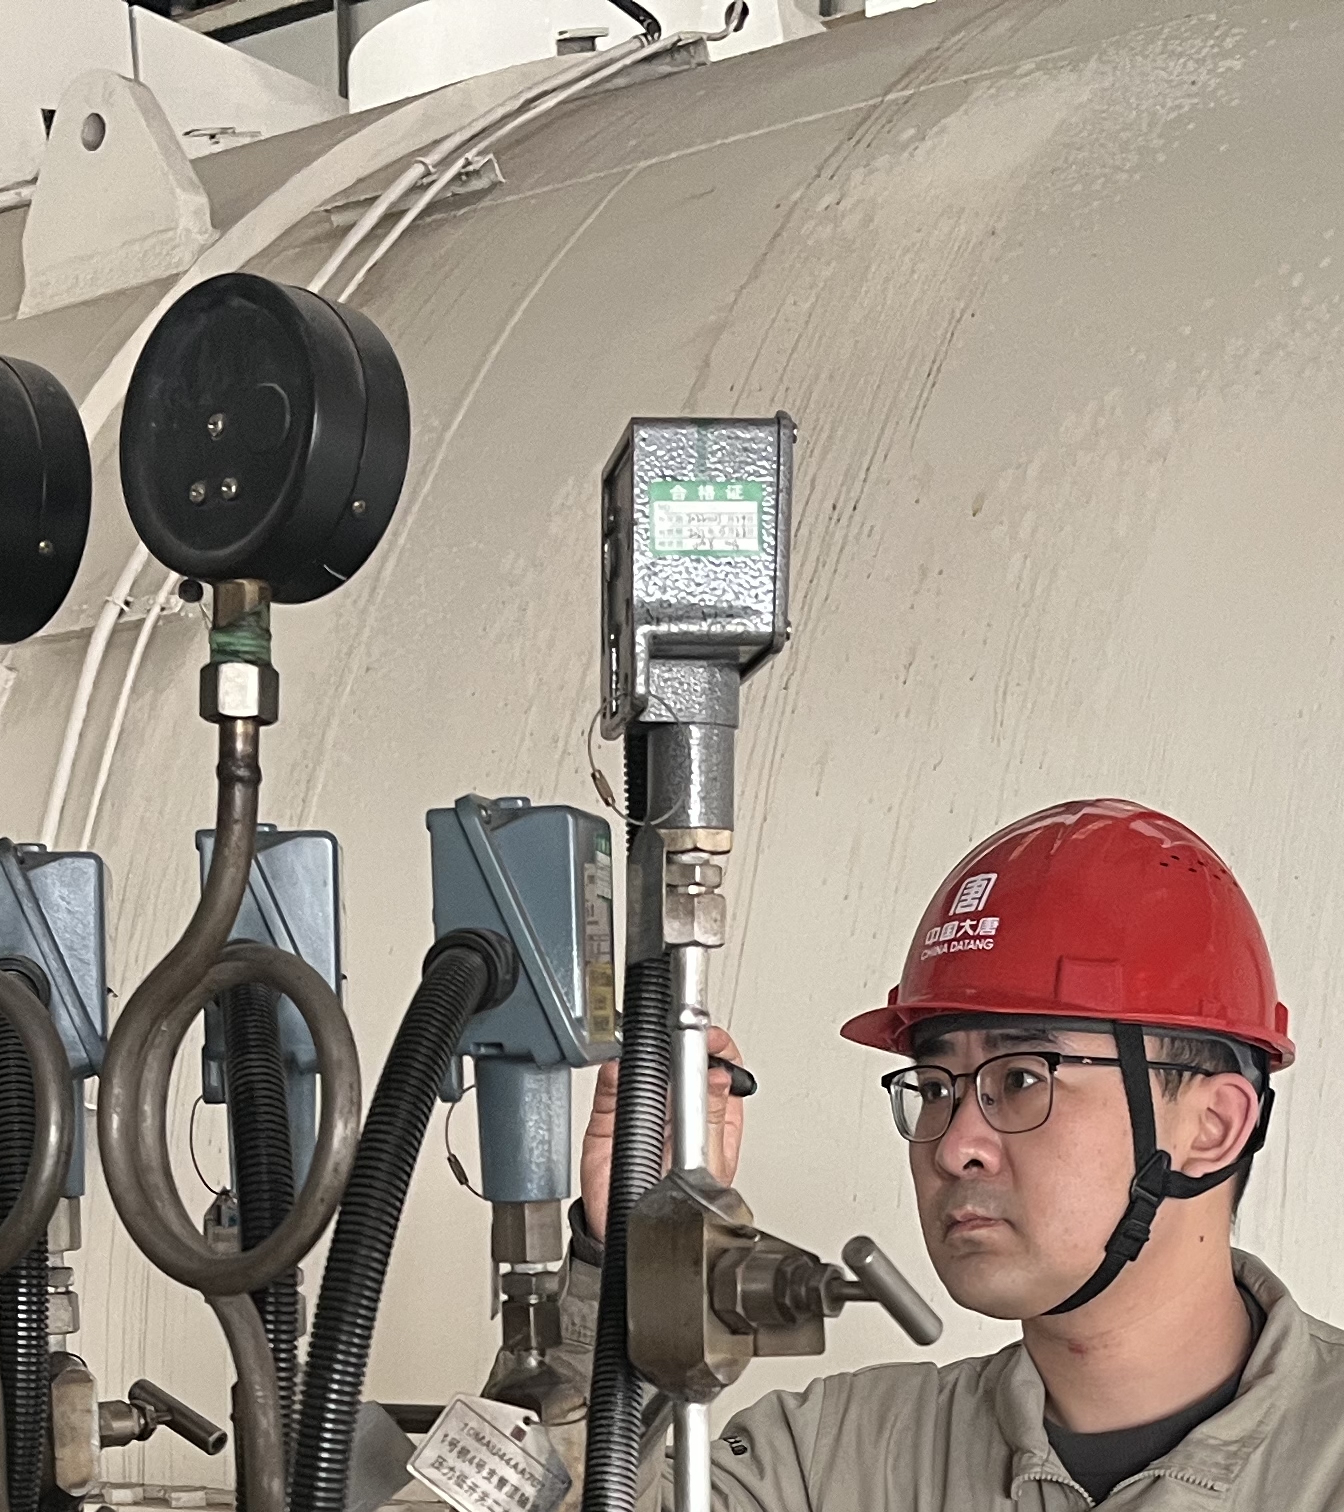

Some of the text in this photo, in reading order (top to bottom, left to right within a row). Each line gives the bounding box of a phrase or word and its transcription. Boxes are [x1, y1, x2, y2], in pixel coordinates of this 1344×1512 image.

[669, 484, 745, 501] 合格证
[925, 917, 1000, 946] 中国大唐
[920, 938, 994, 960] CHINA DATANG
